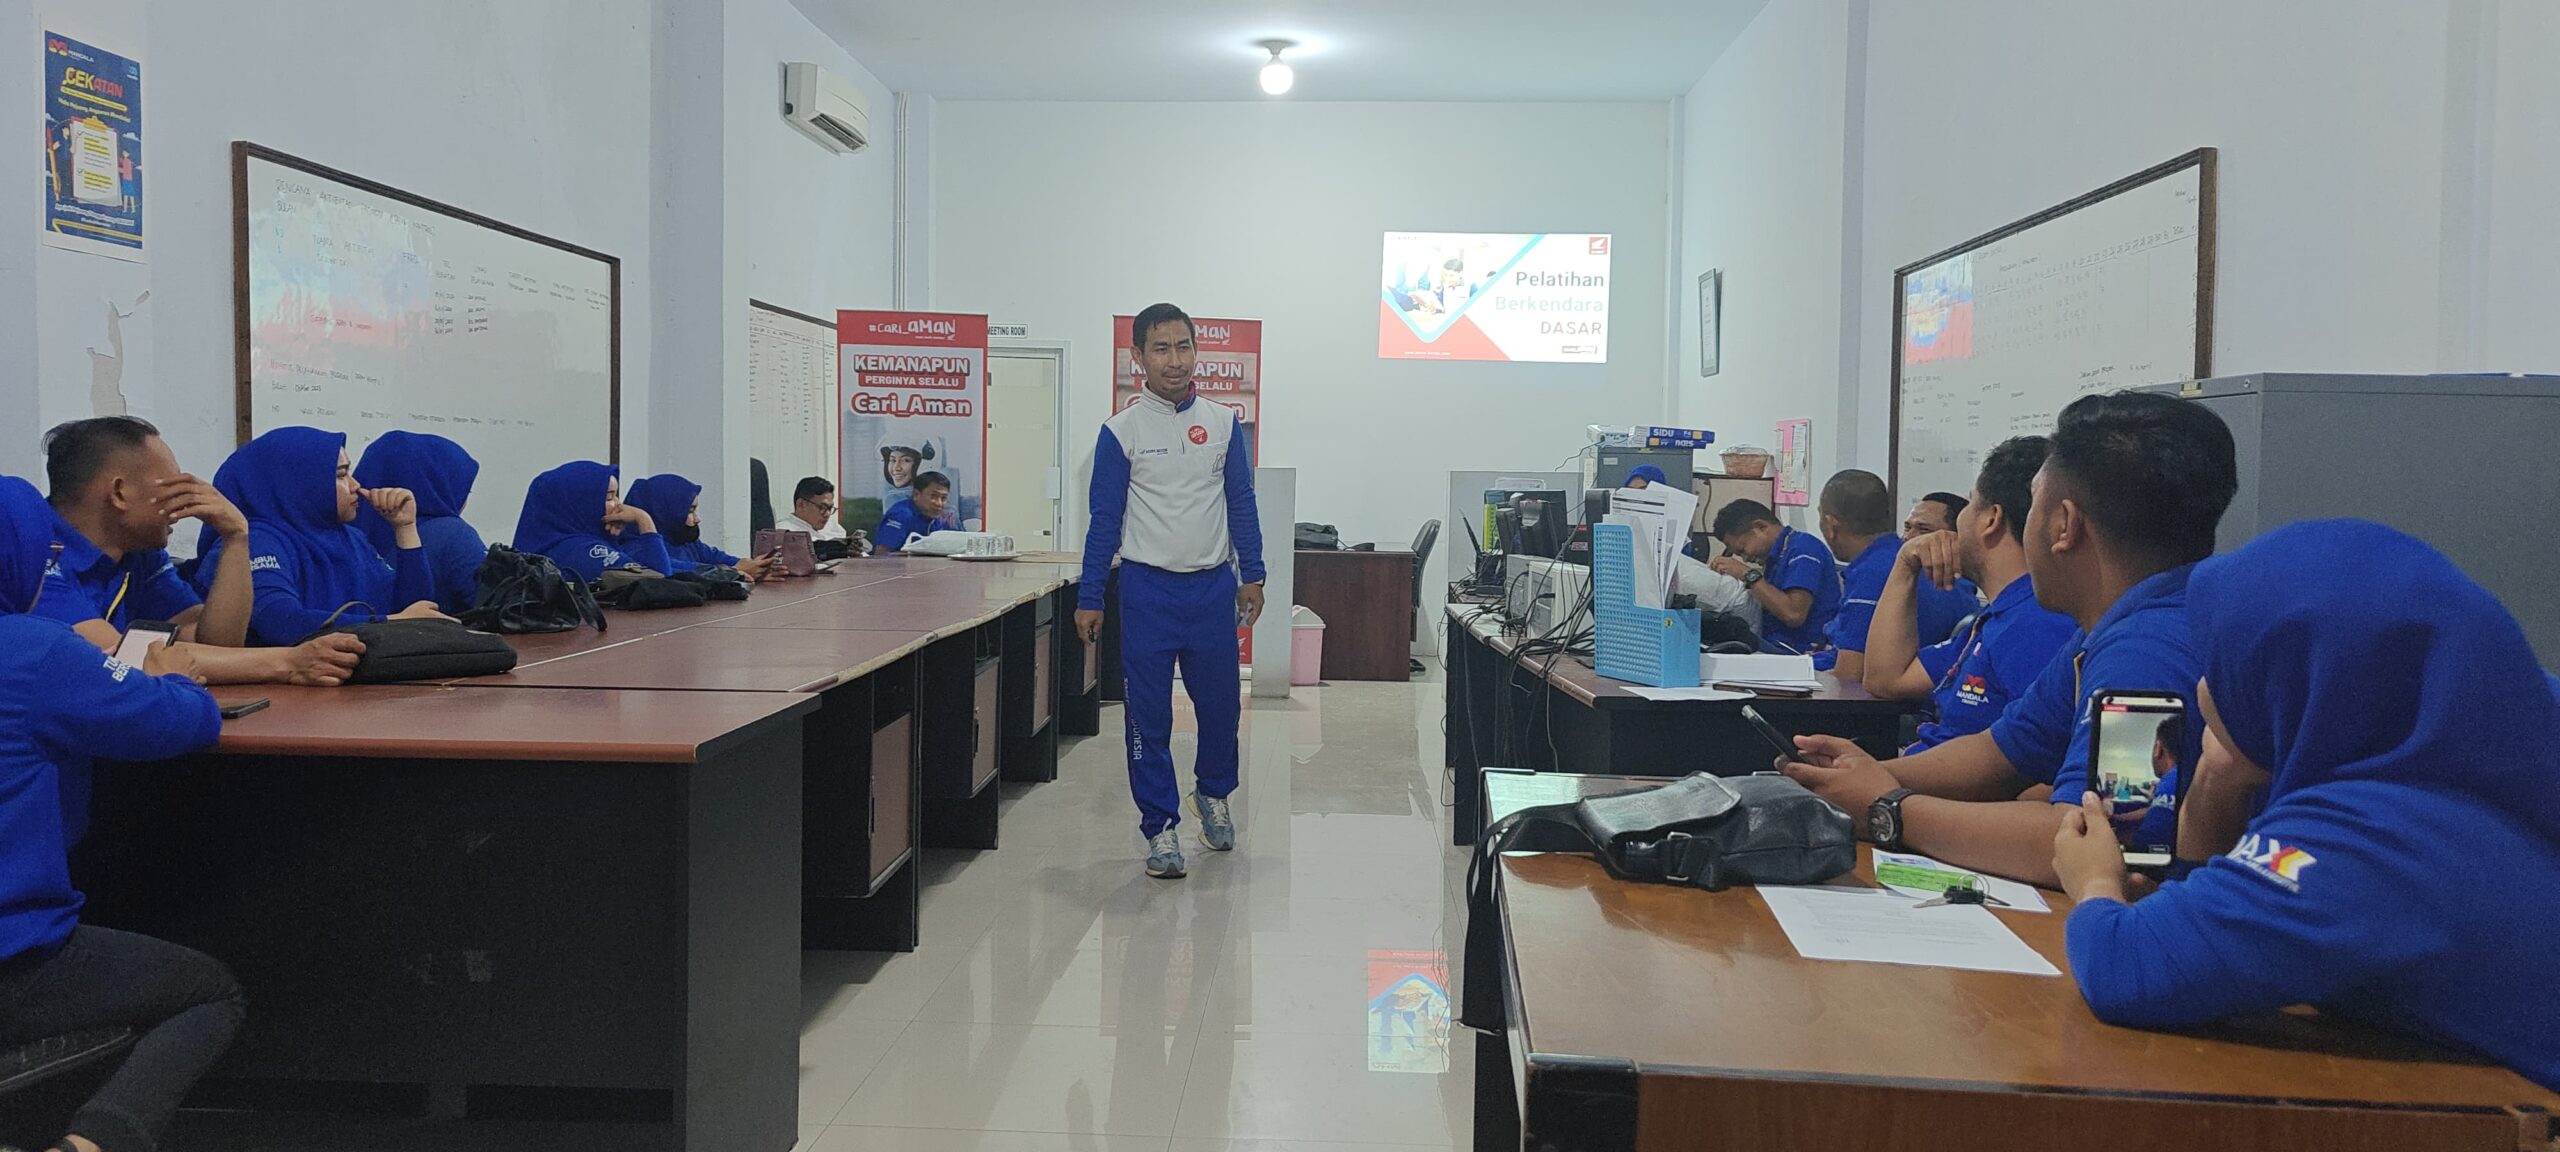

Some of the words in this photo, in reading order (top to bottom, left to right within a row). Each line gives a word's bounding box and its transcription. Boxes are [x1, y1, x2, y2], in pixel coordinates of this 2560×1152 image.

[64, 66, 124, 98] CEKATAN
[1516, 271, 1604, 287] Pelatihan
[1495, 296, 1603, 312] Berkendara
[987, 326, 1009, 336] EETING
[1010, 326, 1026, 336] ROOM
[1540, 321, 1602, 335] DASAR
[854, 355, 969, 375] KEMANAPUN
[865, 375, 916, 386] PERGINYA
[918, 376, 959, 387] SELALU
[854, 394, 971, 415] Cari_Aman
[1956, 690, 1990, 704] MANDALA
